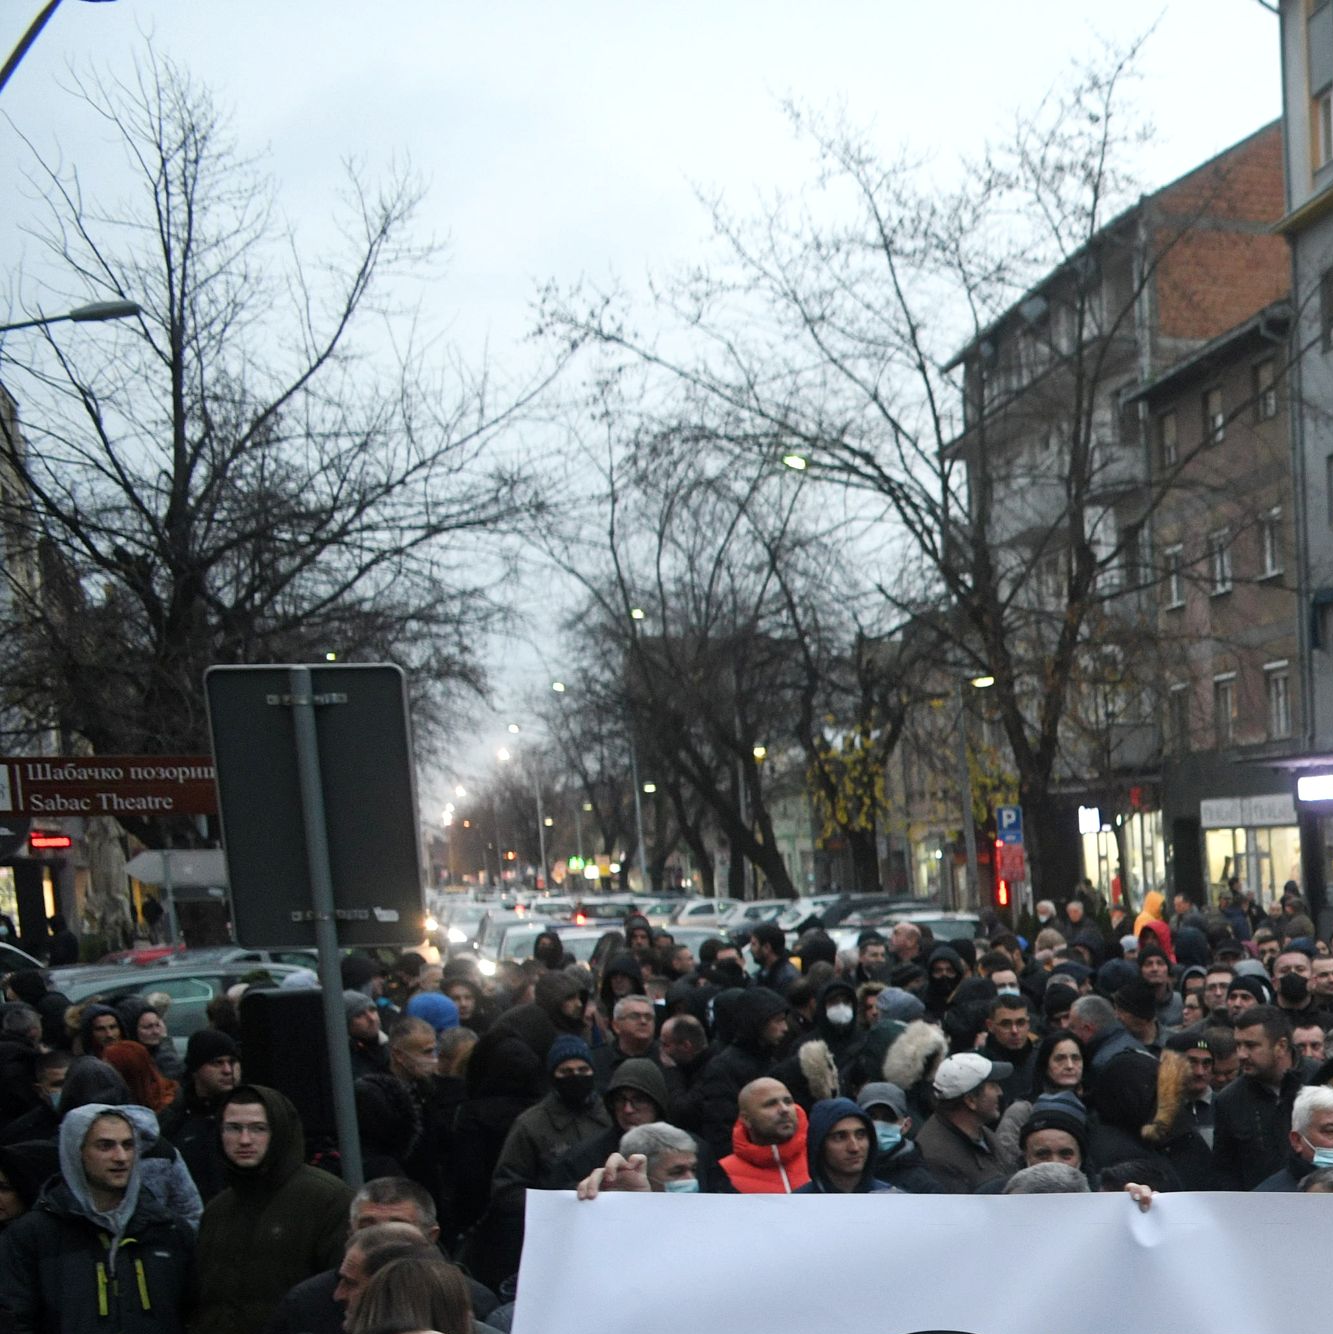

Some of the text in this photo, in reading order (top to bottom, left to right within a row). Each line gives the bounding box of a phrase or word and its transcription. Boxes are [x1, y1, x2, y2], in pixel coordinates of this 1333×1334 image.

[26, 763, 124, 780] Шабачко
[29, 793, 173, 811] Sabac Theatre
